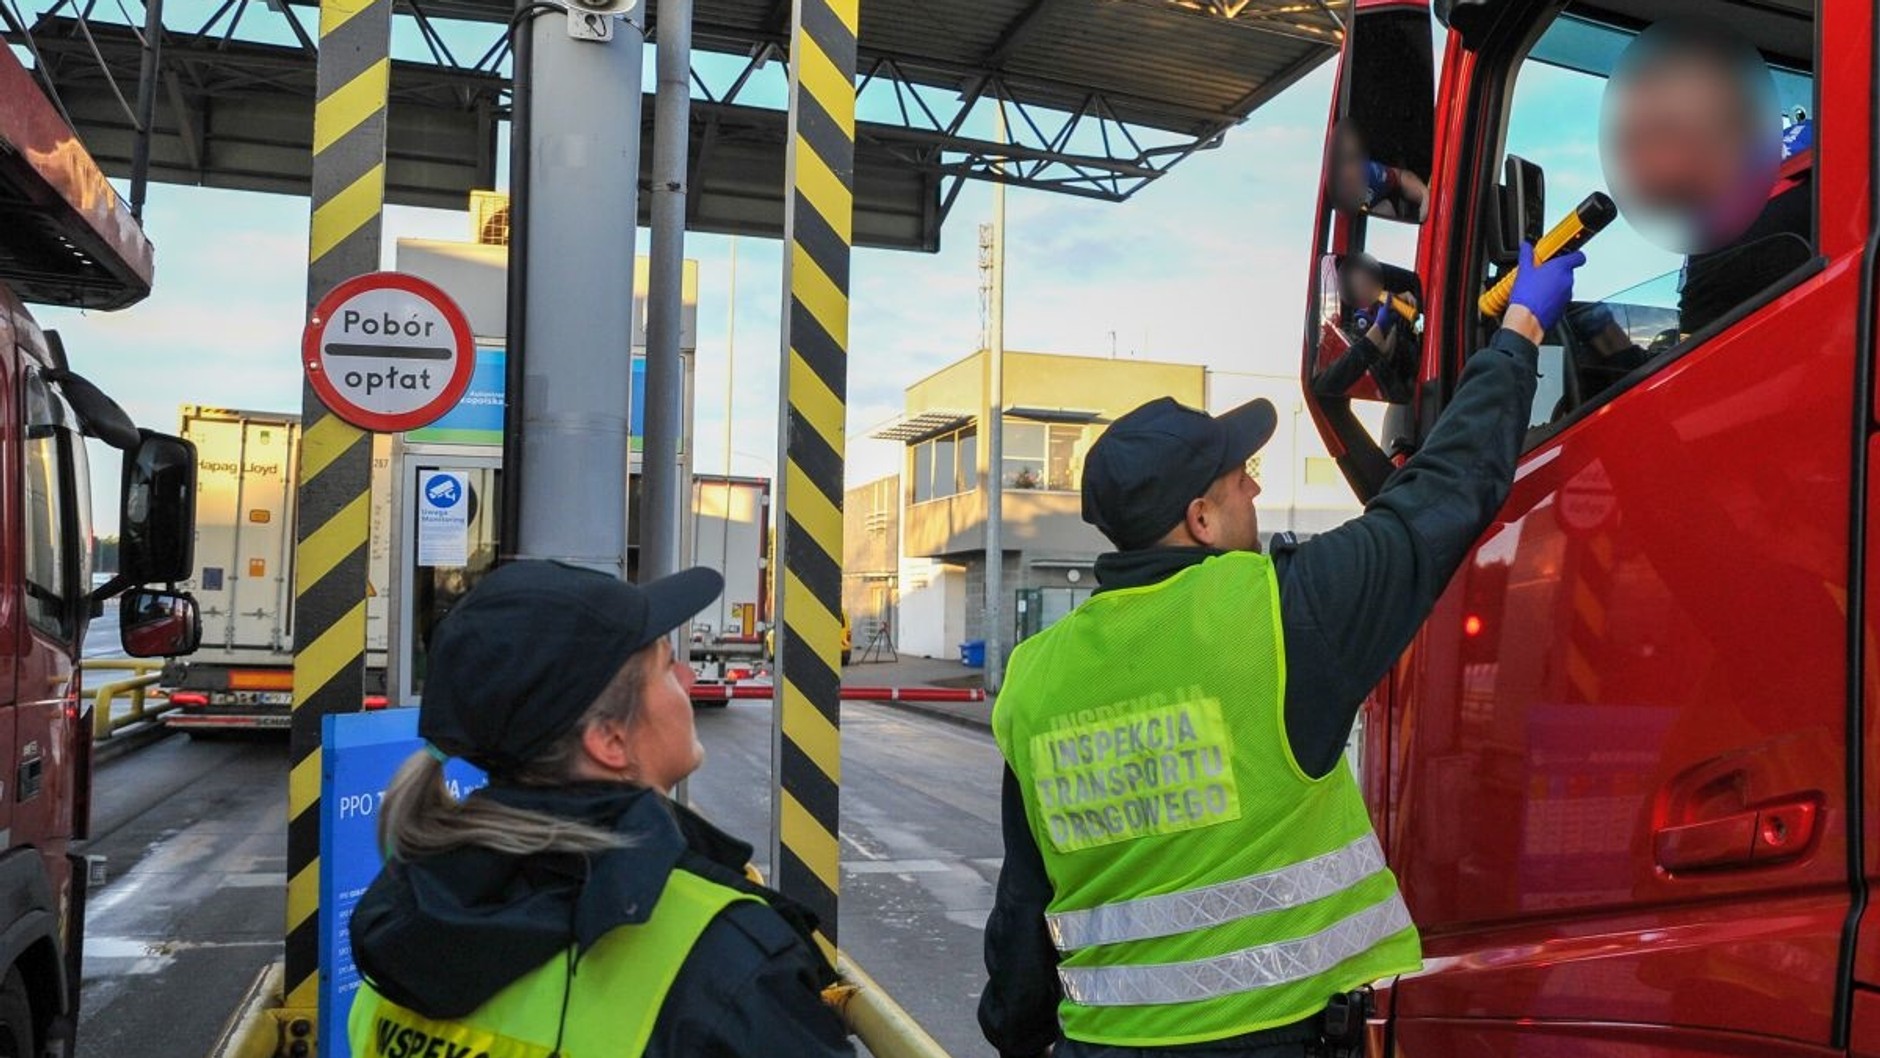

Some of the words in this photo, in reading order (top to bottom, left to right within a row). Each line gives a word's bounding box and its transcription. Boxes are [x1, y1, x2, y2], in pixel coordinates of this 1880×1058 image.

[344, 310, 434, 337] Pobór
[344, 366, 430, 396] opłat
[1048, 710, 1198, 771] INSPEKCJA
[1039, 745, 1223, 808] TRANSPORTU
[339, 793, 373, 819] PPO
[1050, 783, 1228, 845] DROGOWEGO
